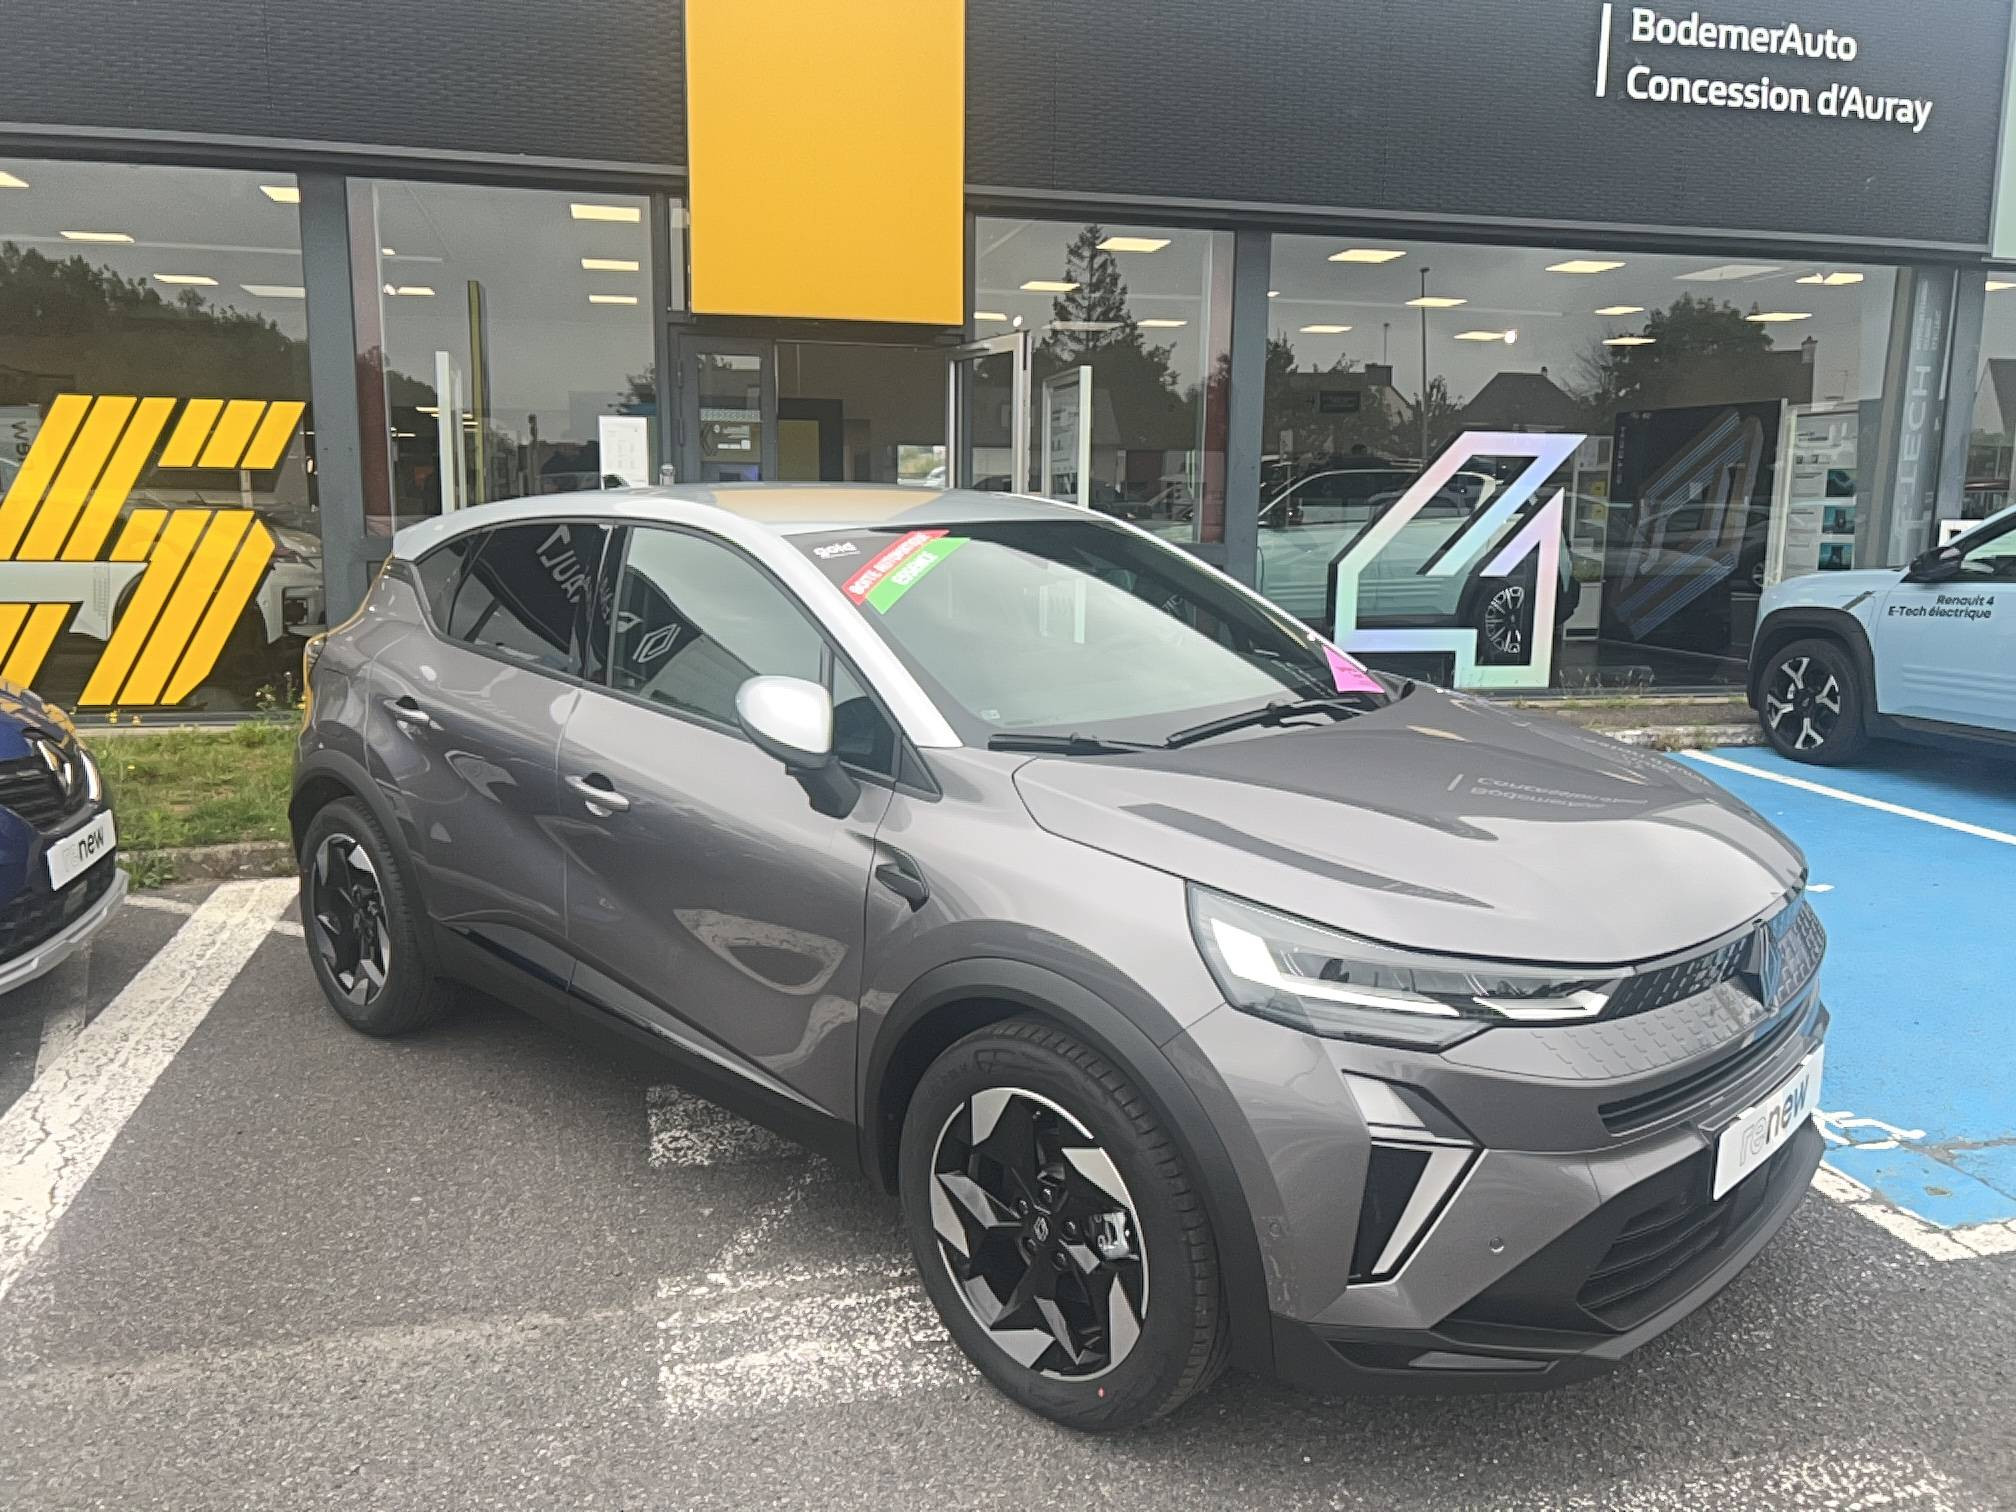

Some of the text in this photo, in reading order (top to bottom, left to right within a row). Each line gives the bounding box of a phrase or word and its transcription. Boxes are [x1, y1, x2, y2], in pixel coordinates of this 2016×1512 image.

[1631, 7, 1859, 62] BodemerAuto
[1626, 65, 1934, 134] Concession d'Auray
[1888, 605, 1992, 621] E-Tech électrique
[1936, 594, 1995, 606] Renault 4
[1739, 1072, 1810, 1168] renew
